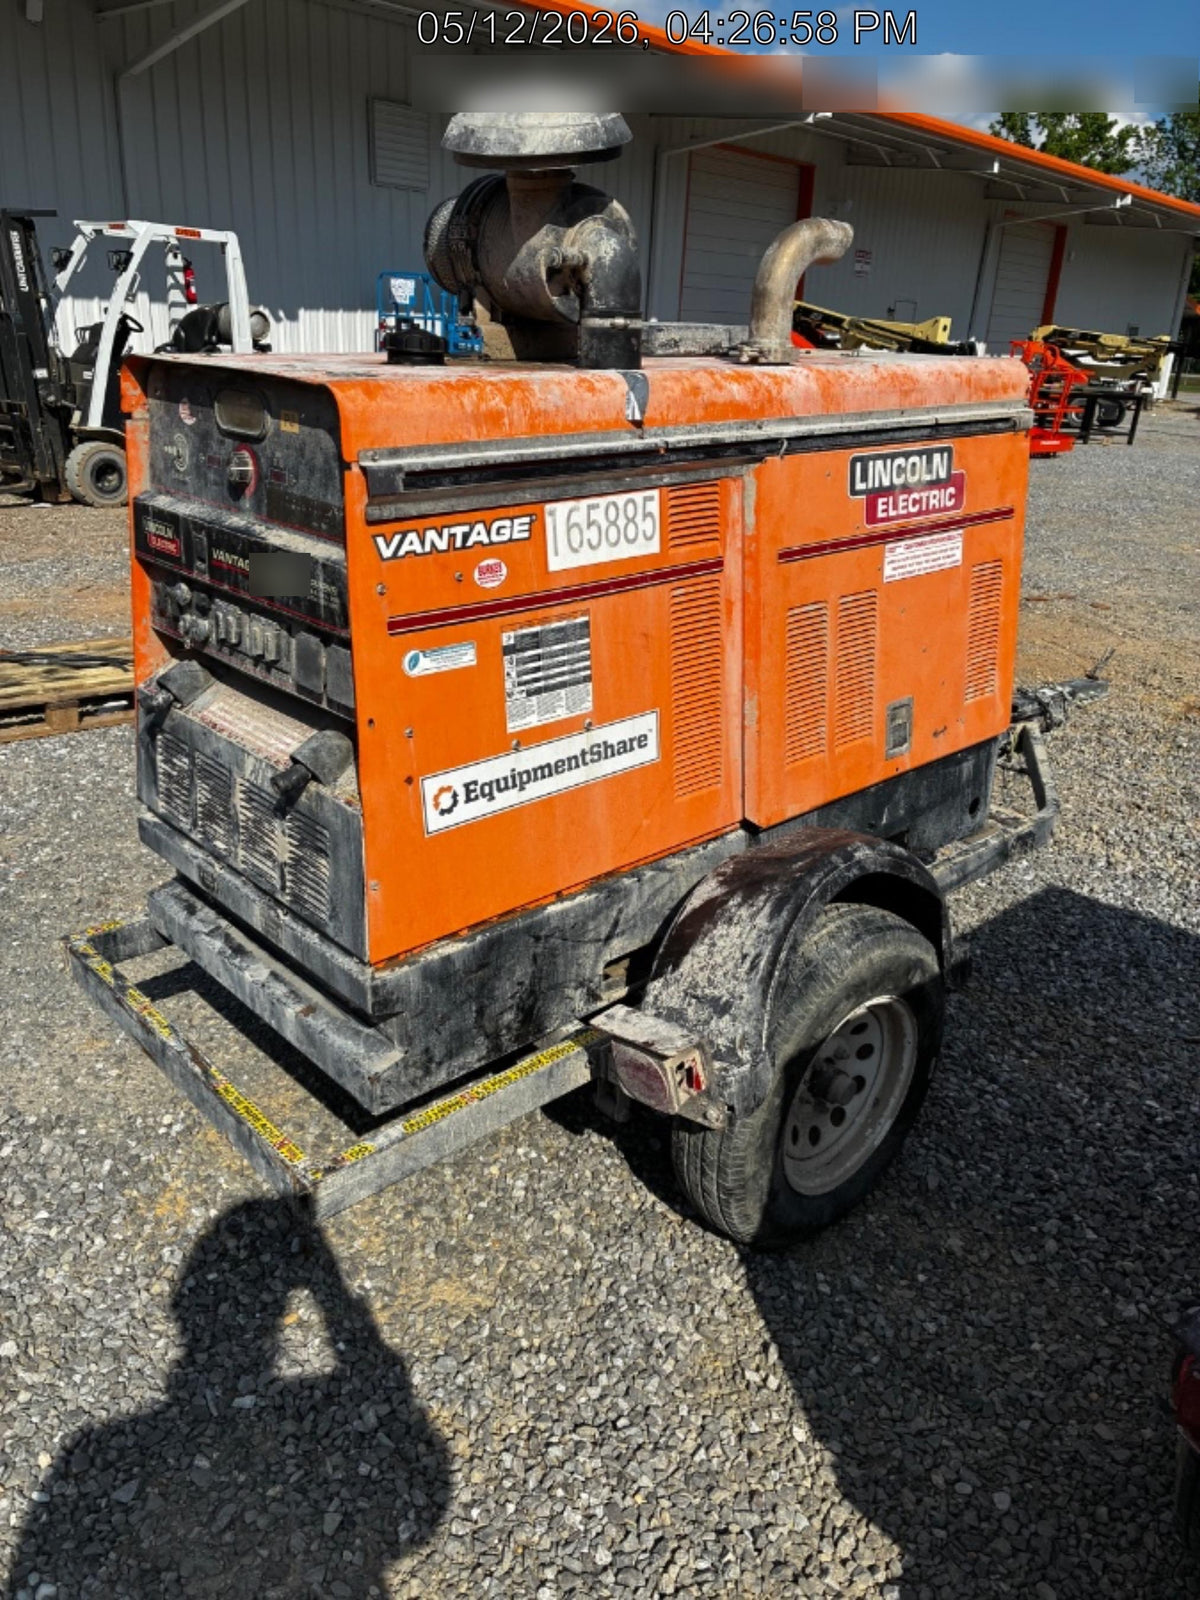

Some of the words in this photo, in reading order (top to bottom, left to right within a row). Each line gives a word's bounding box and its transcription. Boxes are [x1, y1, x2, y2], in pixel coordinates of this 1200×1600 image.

[854, 452, 948, 491] LINCOLN
[877, 487, 956, 518] ELECTRIC
[374, 515, 533, 560] VANTAGE
[548, 496, 657, 557] 165885
[212, 548, 249, 571] VANTAG
[463, 732, 648, 804] EquipmentShare
